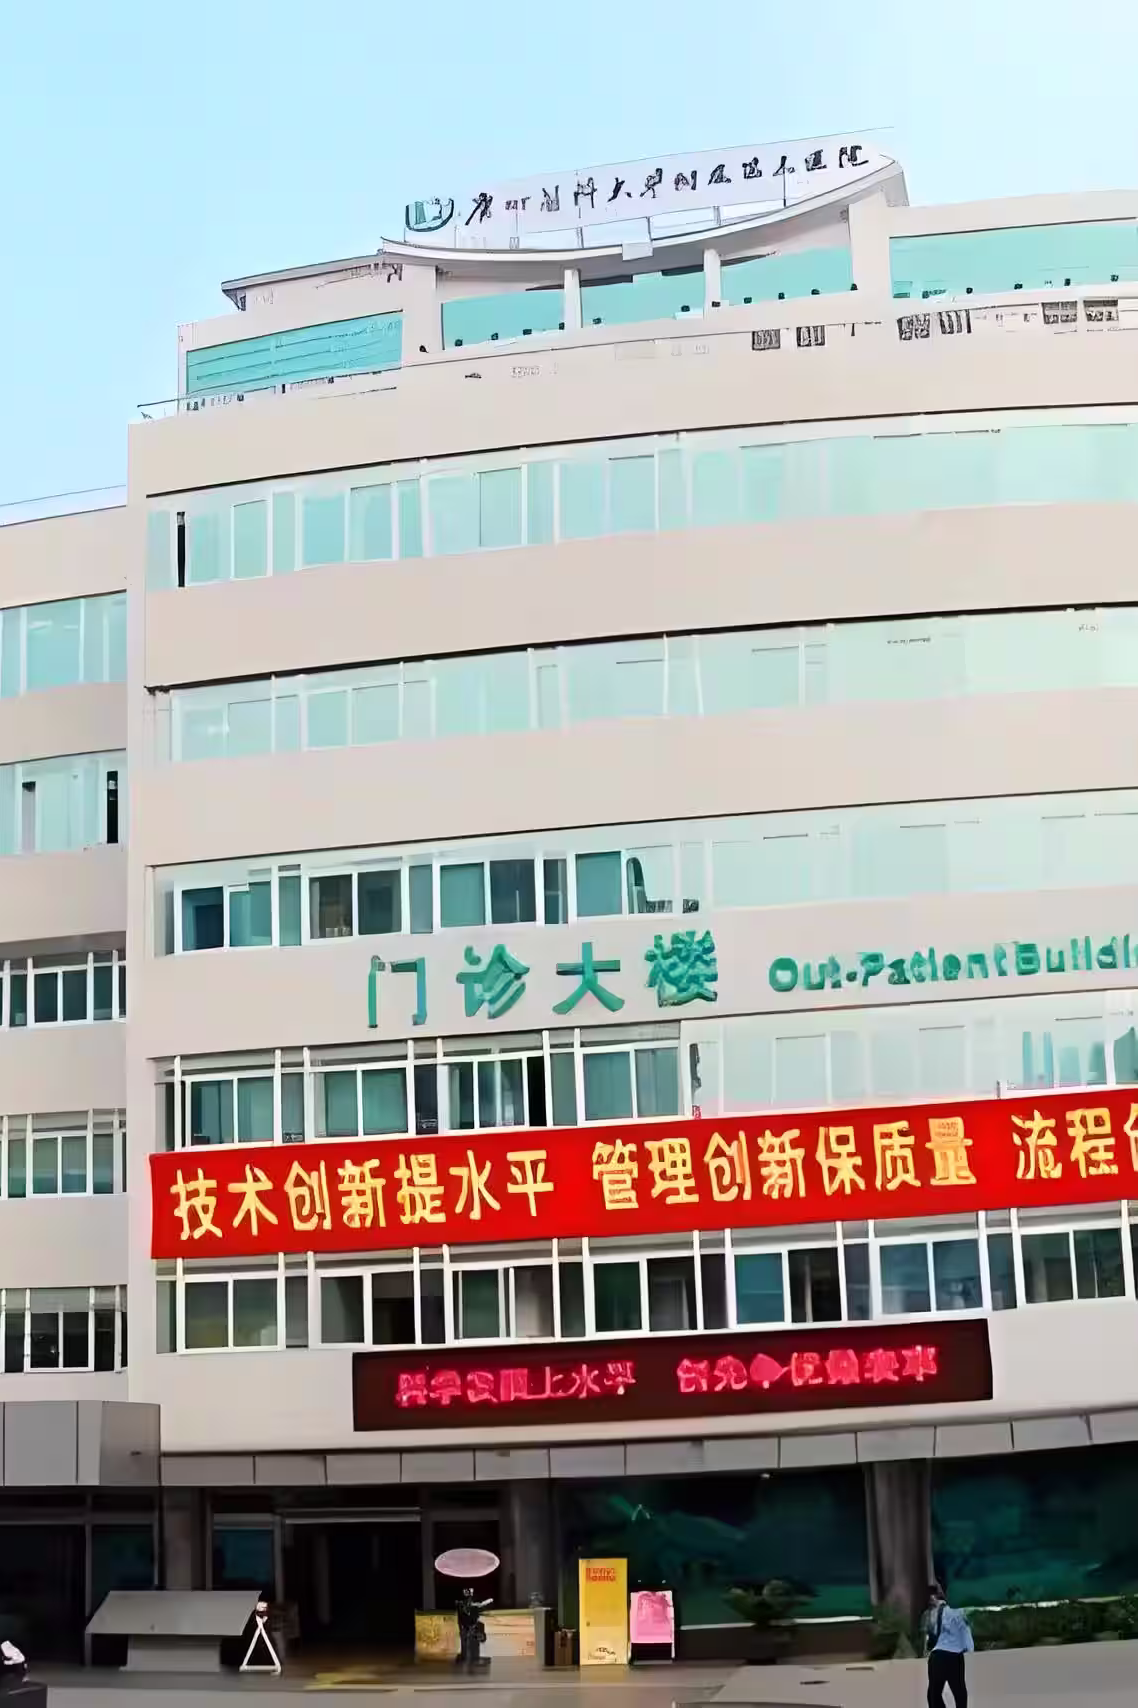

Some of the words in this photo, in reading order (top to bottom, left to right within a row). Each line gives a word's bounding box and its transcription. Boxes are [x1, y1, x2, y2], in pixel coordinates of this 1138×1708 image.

[367, 930, 719, 1028] 门诊大楼
[170, 1149, 556, 1241] 技术创新提水平
[592, 1116, 977, 1211] 管理创新保质量
